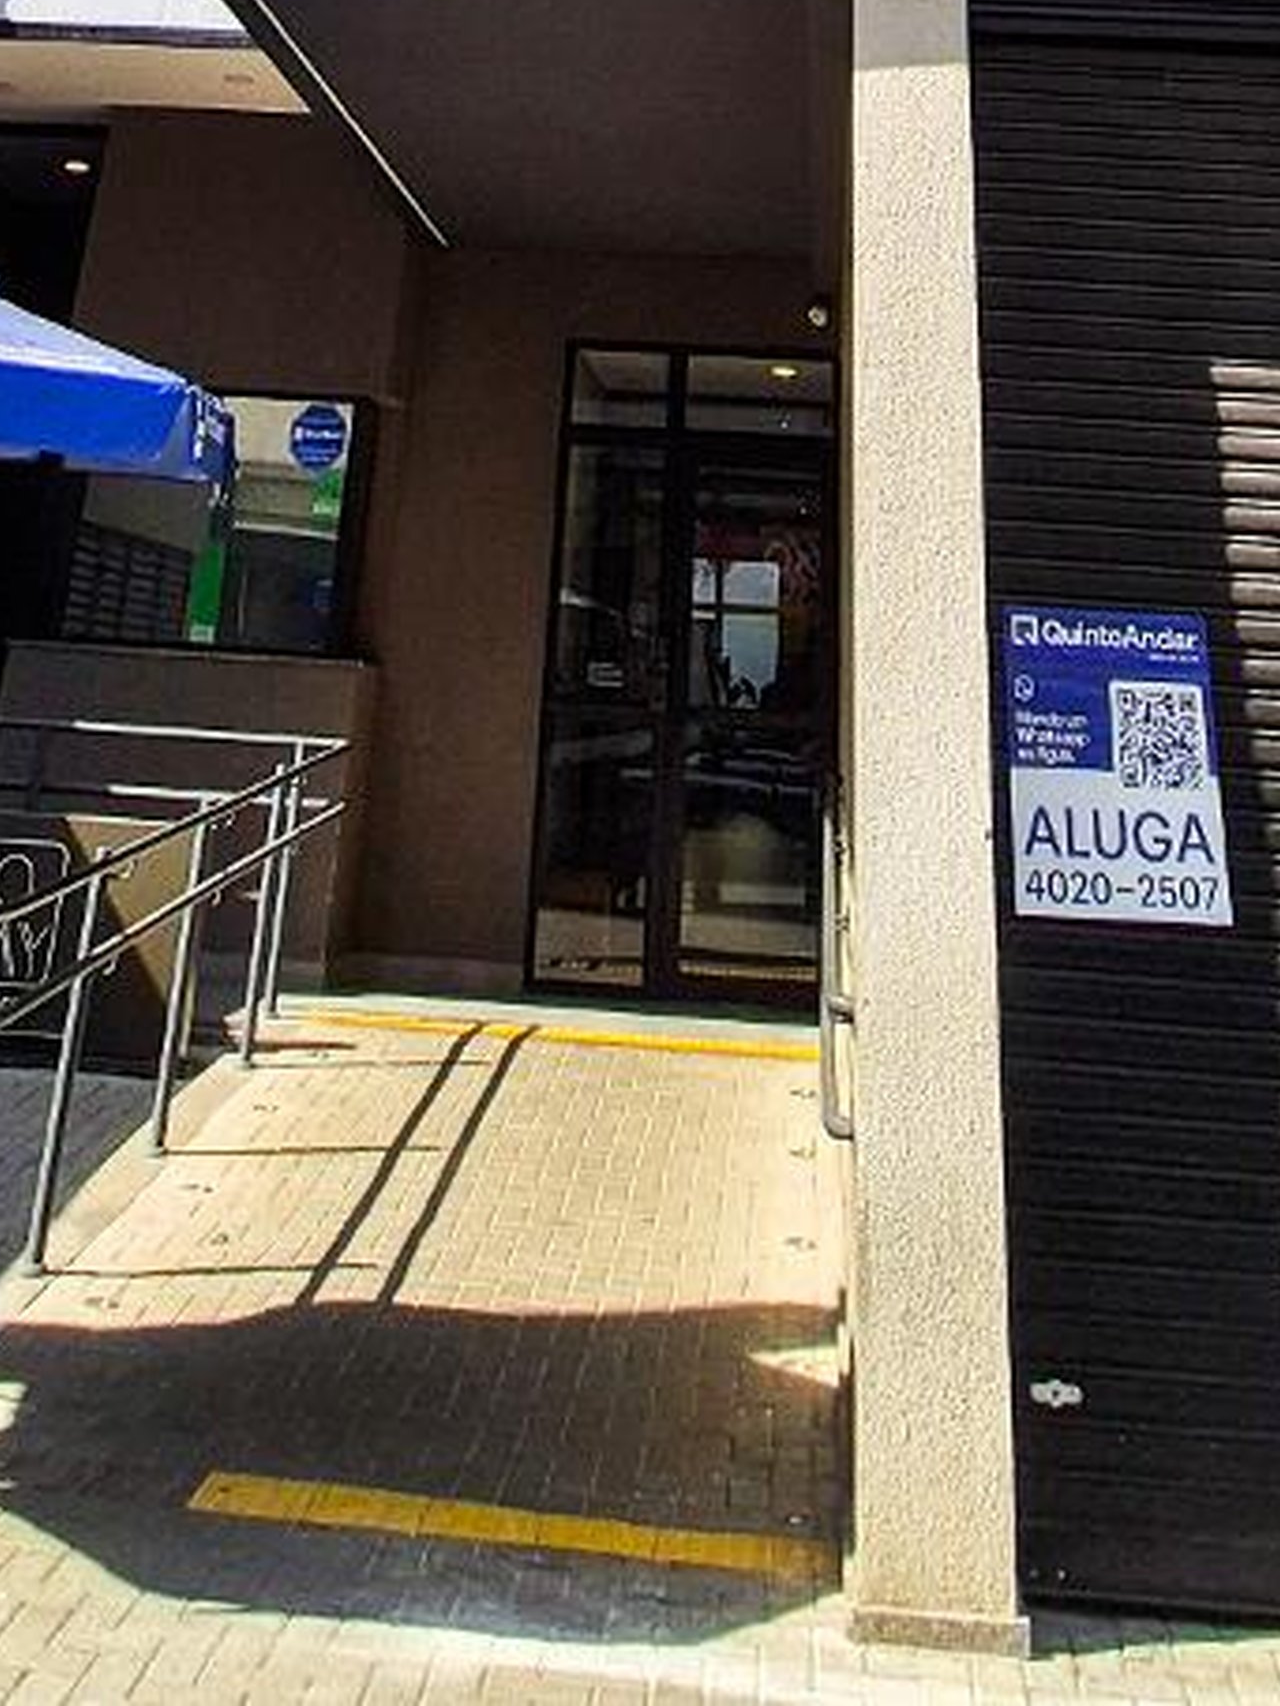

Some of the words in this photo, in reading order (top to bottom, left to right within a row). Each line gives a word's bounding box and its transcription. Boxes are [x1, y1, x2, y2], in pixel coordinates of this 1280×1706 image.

[1041, 618, 1200, 652] QuintoAndar
[1025, 805, 1216, 865] ALUGA
[1025, 870, 1220, 912] 4020-2507
